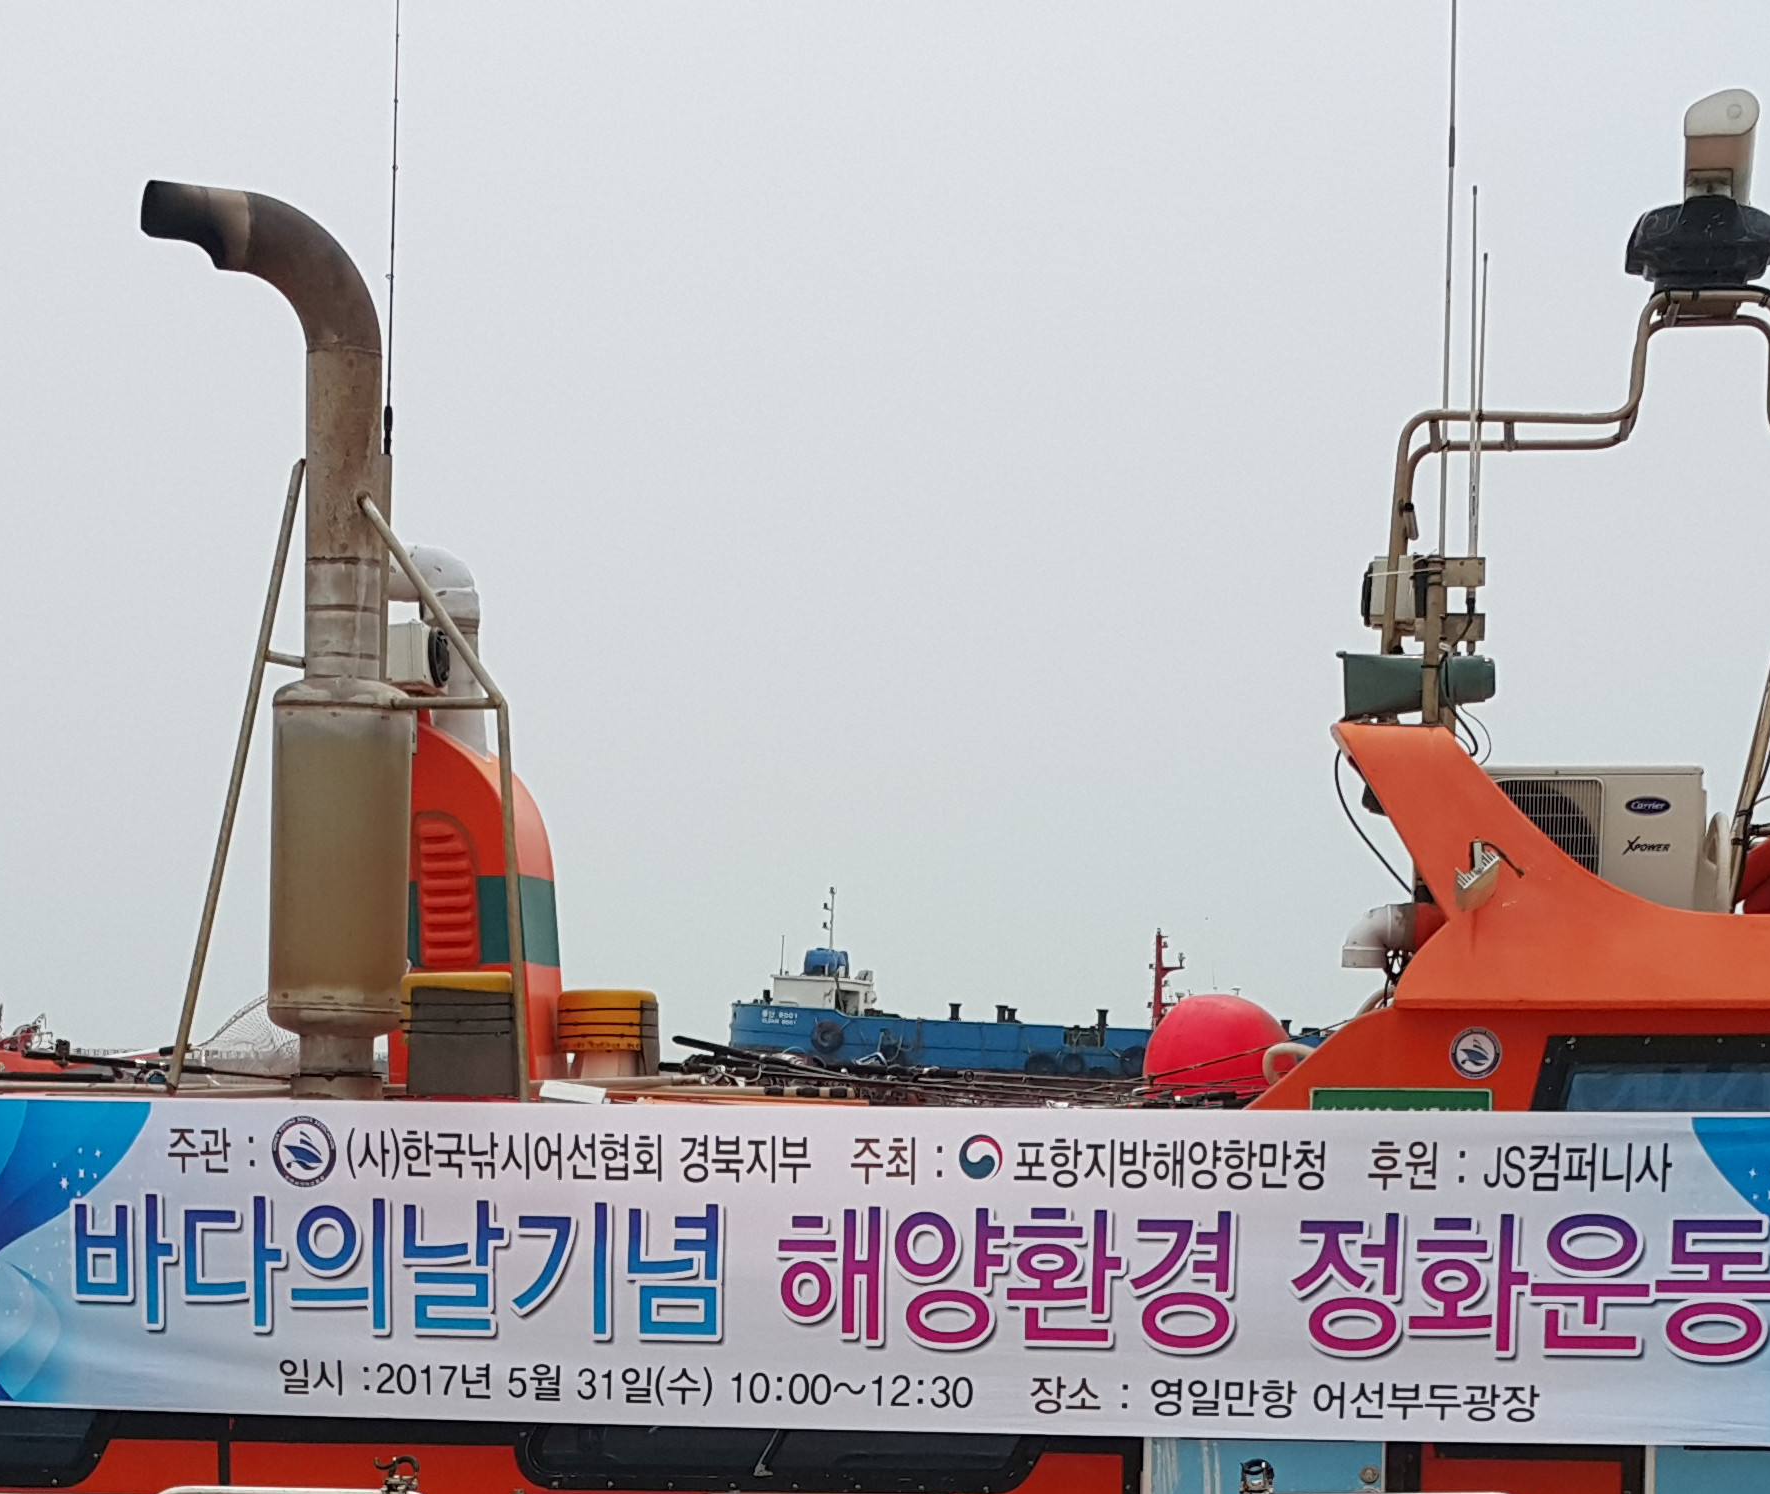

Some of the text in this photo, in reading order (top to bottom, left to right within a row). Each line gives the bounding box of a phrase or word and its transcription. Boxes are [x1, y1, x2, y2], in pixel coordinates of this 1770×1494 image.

[1630, 801, 1667, 810] Carrier
[167, 1128, 232, 1174] 주관
[346, 1128, 663, 1183] (사)한국낚시어선협회
[679, 1134, 812, 1184] 경북지부
[850, 1136, 917, 1186] 주최
[1013, 1138, 1326, 1191] 포항지방해양항만청
[1367, 1141, 1438, 1191] 후원
[1483, 1142, 1673, 1193] JS컴퍼니사
[70, 1190, 725, 1342] 바다의날기념
[775, 1204, 1237, 1350] 해양환경
[279, 1358, 343, 1397] 일시
[508, 1363, 561, 1402] 5월
[576, 1365, 713, 1407] 31일(수)
[1030, 1376, 1102, 1415] 장소
[1150, 1378, 1298, 1419] 영일만항
[1313, 1381, 1540, 1424] 어선부두광장
